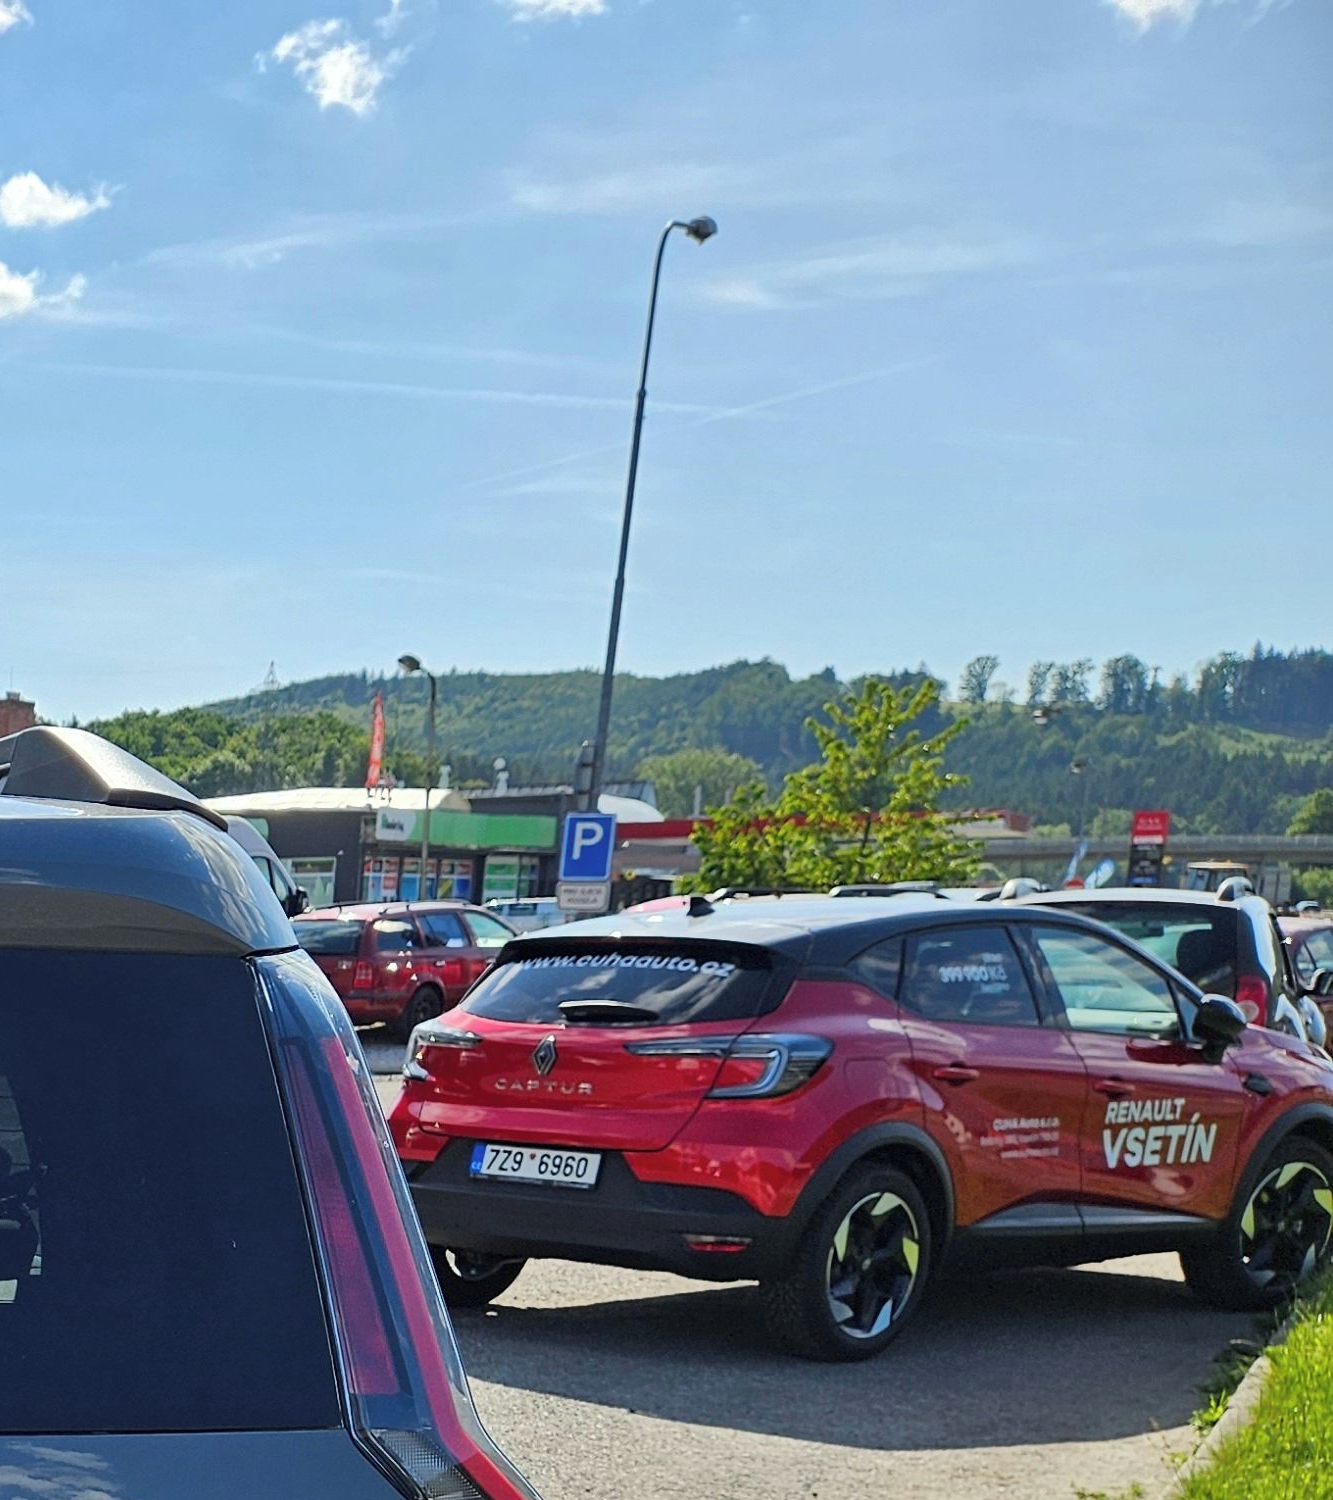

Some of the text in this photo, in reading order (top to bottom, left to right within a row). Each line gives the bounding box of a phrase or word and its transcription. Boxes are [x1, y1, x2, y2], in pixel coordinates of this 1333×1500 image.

[571, 821, 604, 861] P
[520, 952, 735, 978] www.cuhaauto.cz
[494, 1078, 593, 1095] CAPTUR
[1104, 1097, 1187, 1125] RENAULT
[1102, 1112, 1218, 1169] VSETÍN
[486, 1148, 589, 1179] 7Z9 6960
